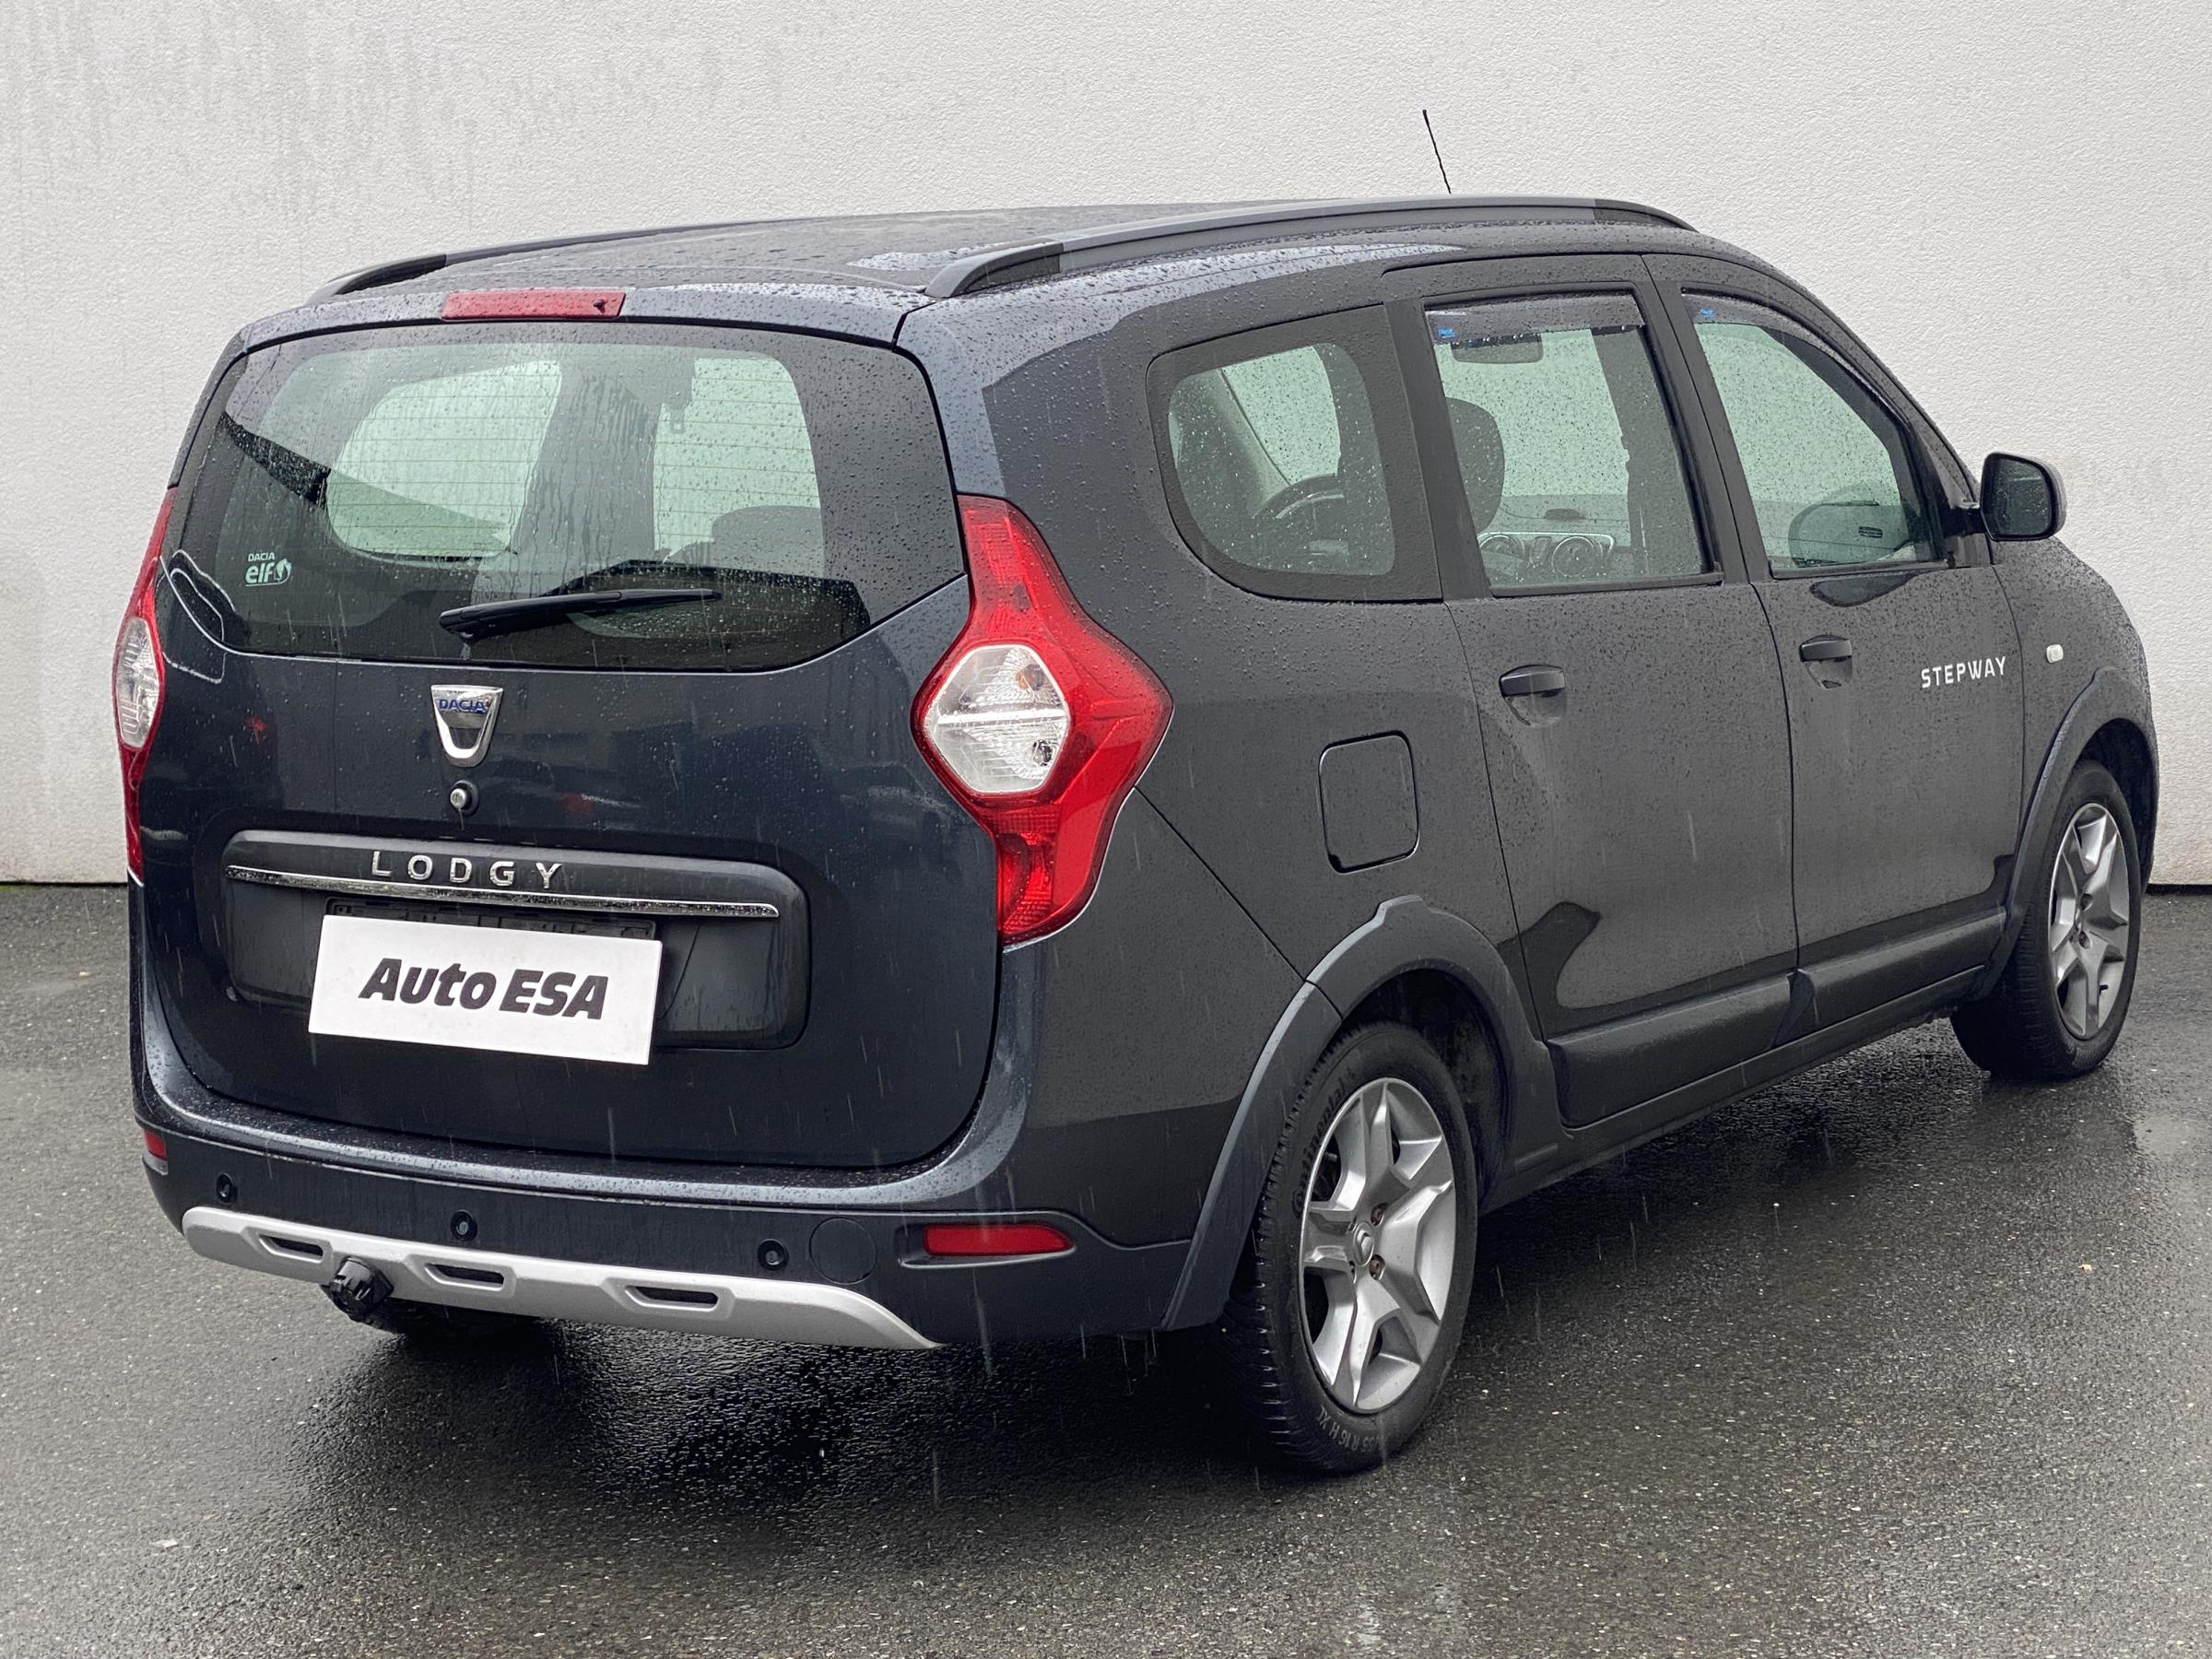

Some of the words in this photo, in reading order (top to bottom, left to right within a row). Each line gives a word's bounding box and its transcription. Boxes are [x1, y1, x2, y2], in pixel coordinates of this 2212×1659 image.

[247, 552, 276, 562] DACIA
[245, 561, 276, 583] elf
[1921, 655, 2006, 688] STEPWAY
[439, 699, 488, 713] DACIA
[371, 851, 562, 889] LODGY
[358, 958, 497, 1010] Auto
[499, 969, 608, 1020] ESA
